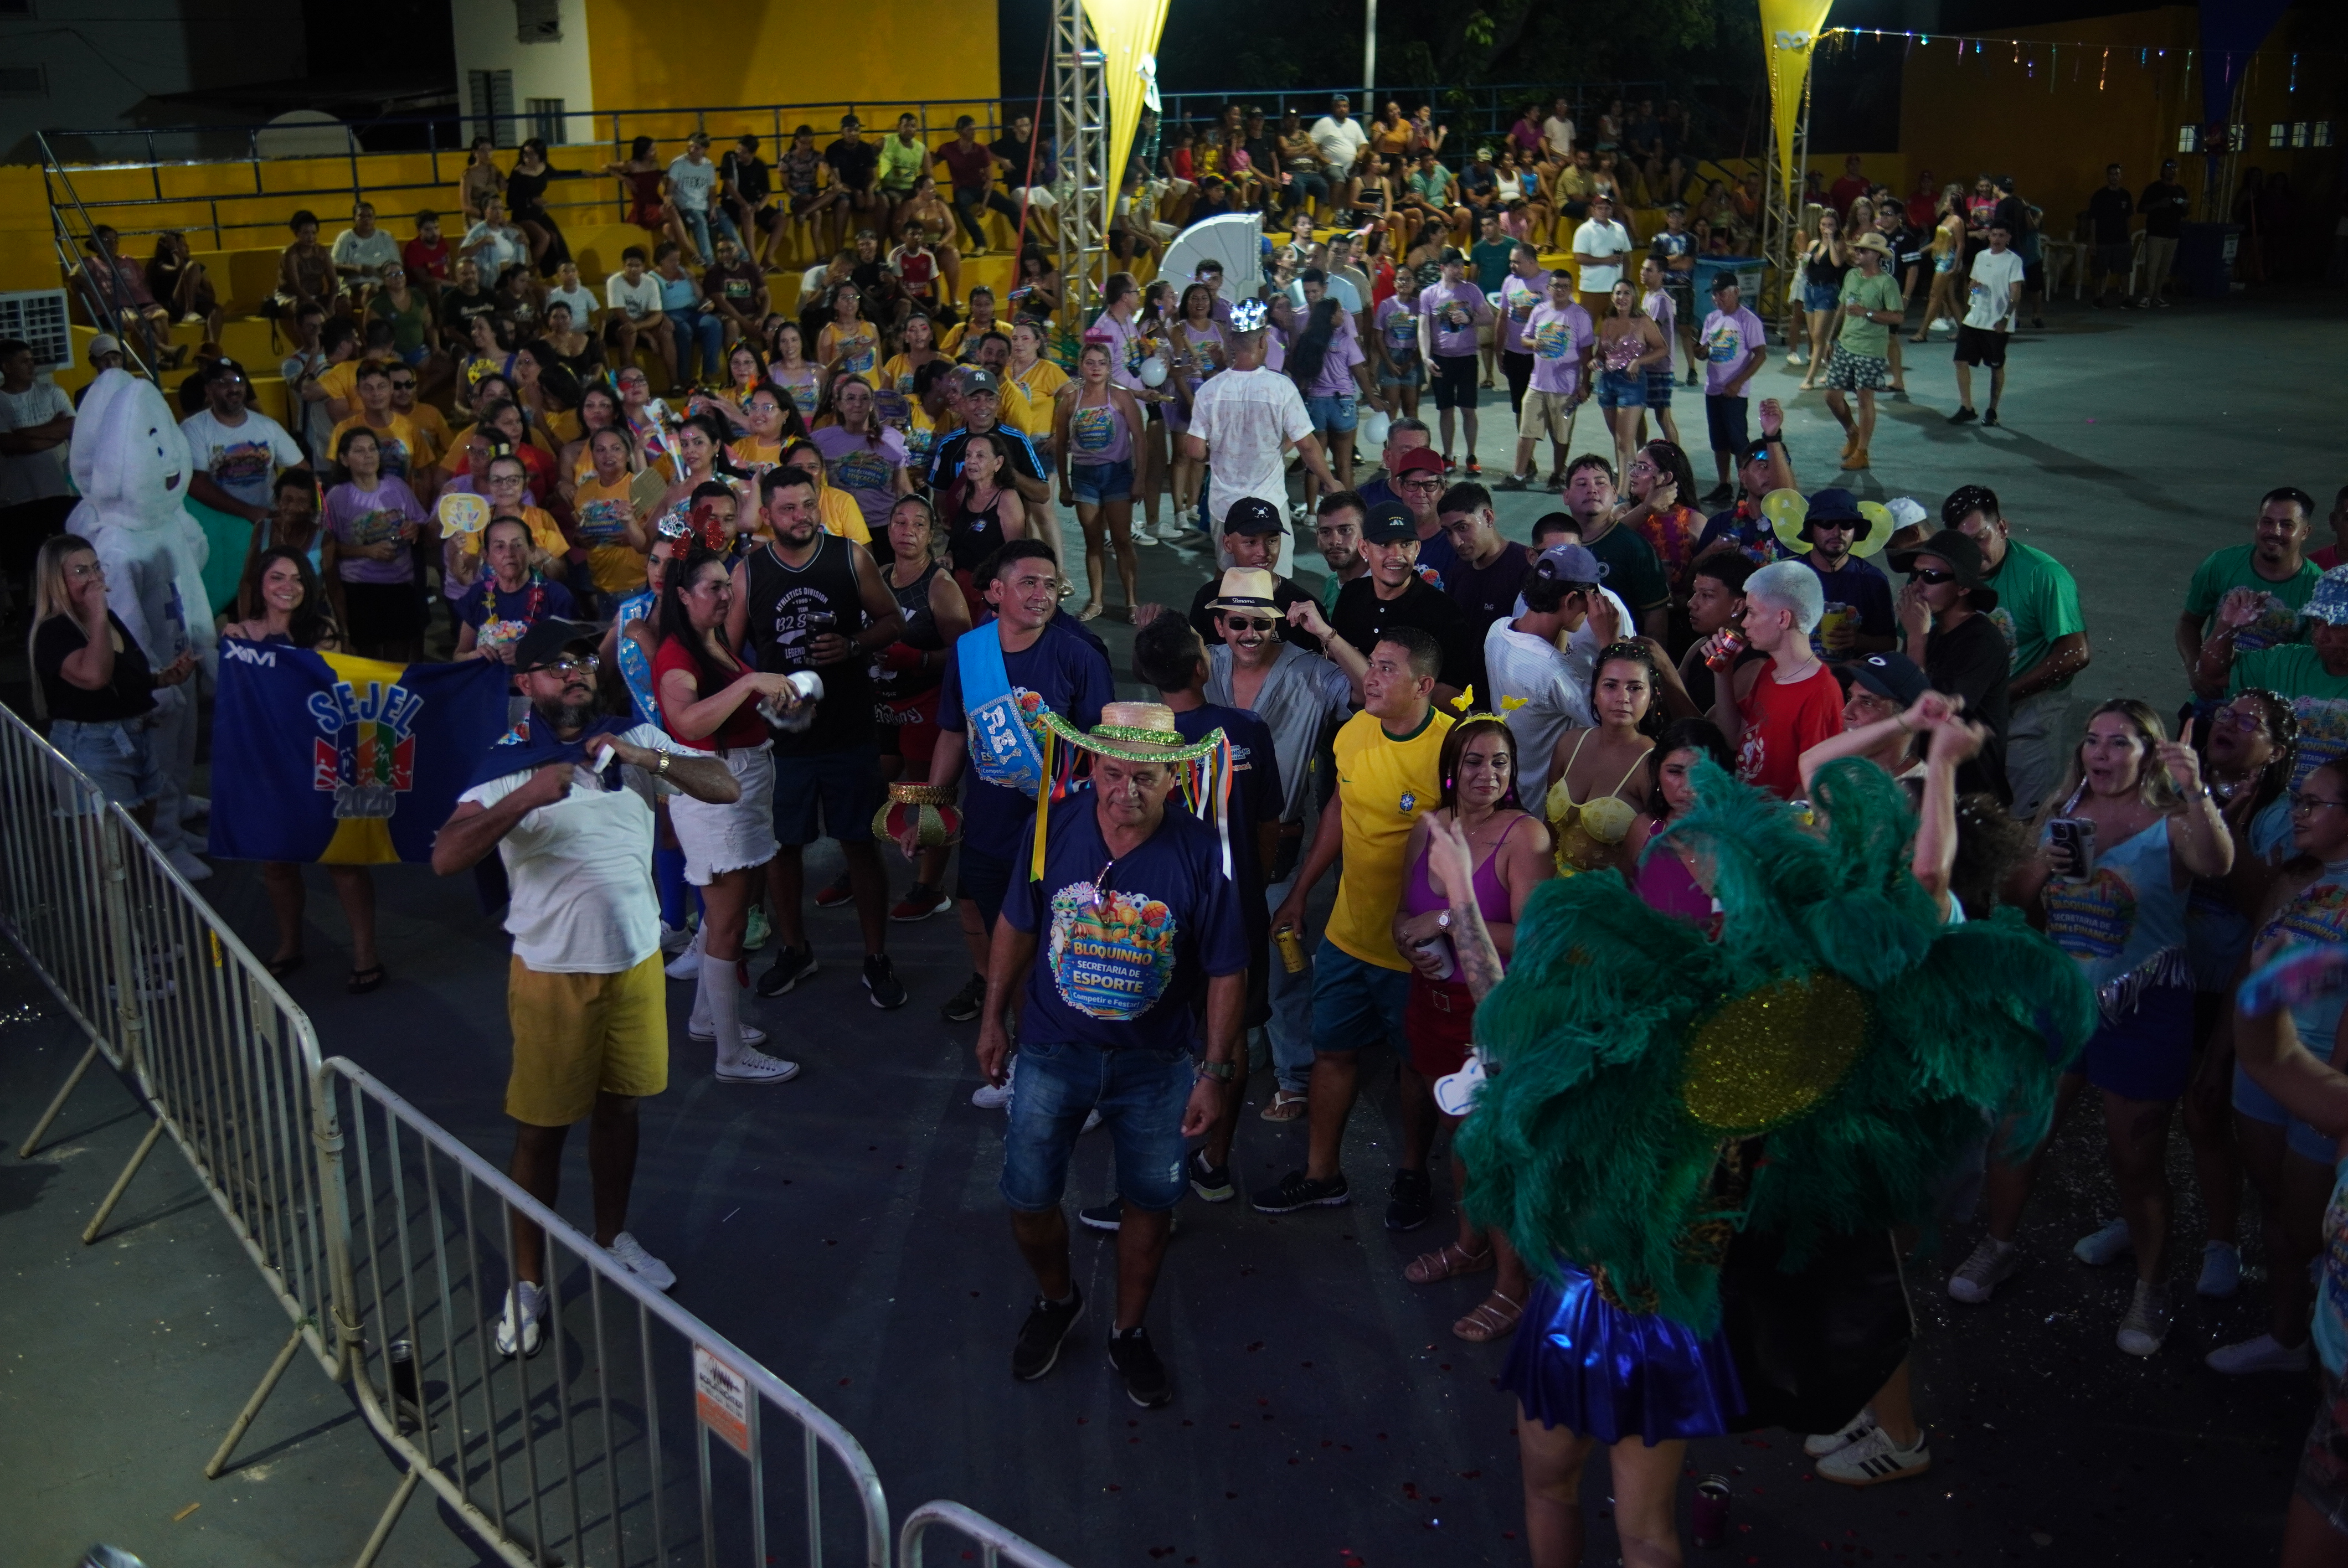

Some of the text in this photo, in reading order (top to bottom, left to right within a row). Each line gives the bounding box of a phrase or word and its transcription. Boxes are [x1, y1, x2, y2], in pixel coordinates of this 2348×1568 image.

[975, 372, 986, 381] NY
[776, 587, 828, 613] ATHLETICS DIVISION
[306, 679, 425, 740] SEJEL
[2052, 914, 2113, 931] SECRETARIA DE
[1074, 942, 1152, 966] BLOQUINHO
[1077, 960, 1141, 978] SECRETARIA DE
[1073, 970, 1145, 993] ESPORTE
[1073, 992, 1107, 1004] Competir
[1114, 999, 1140, 1009] Festar!
